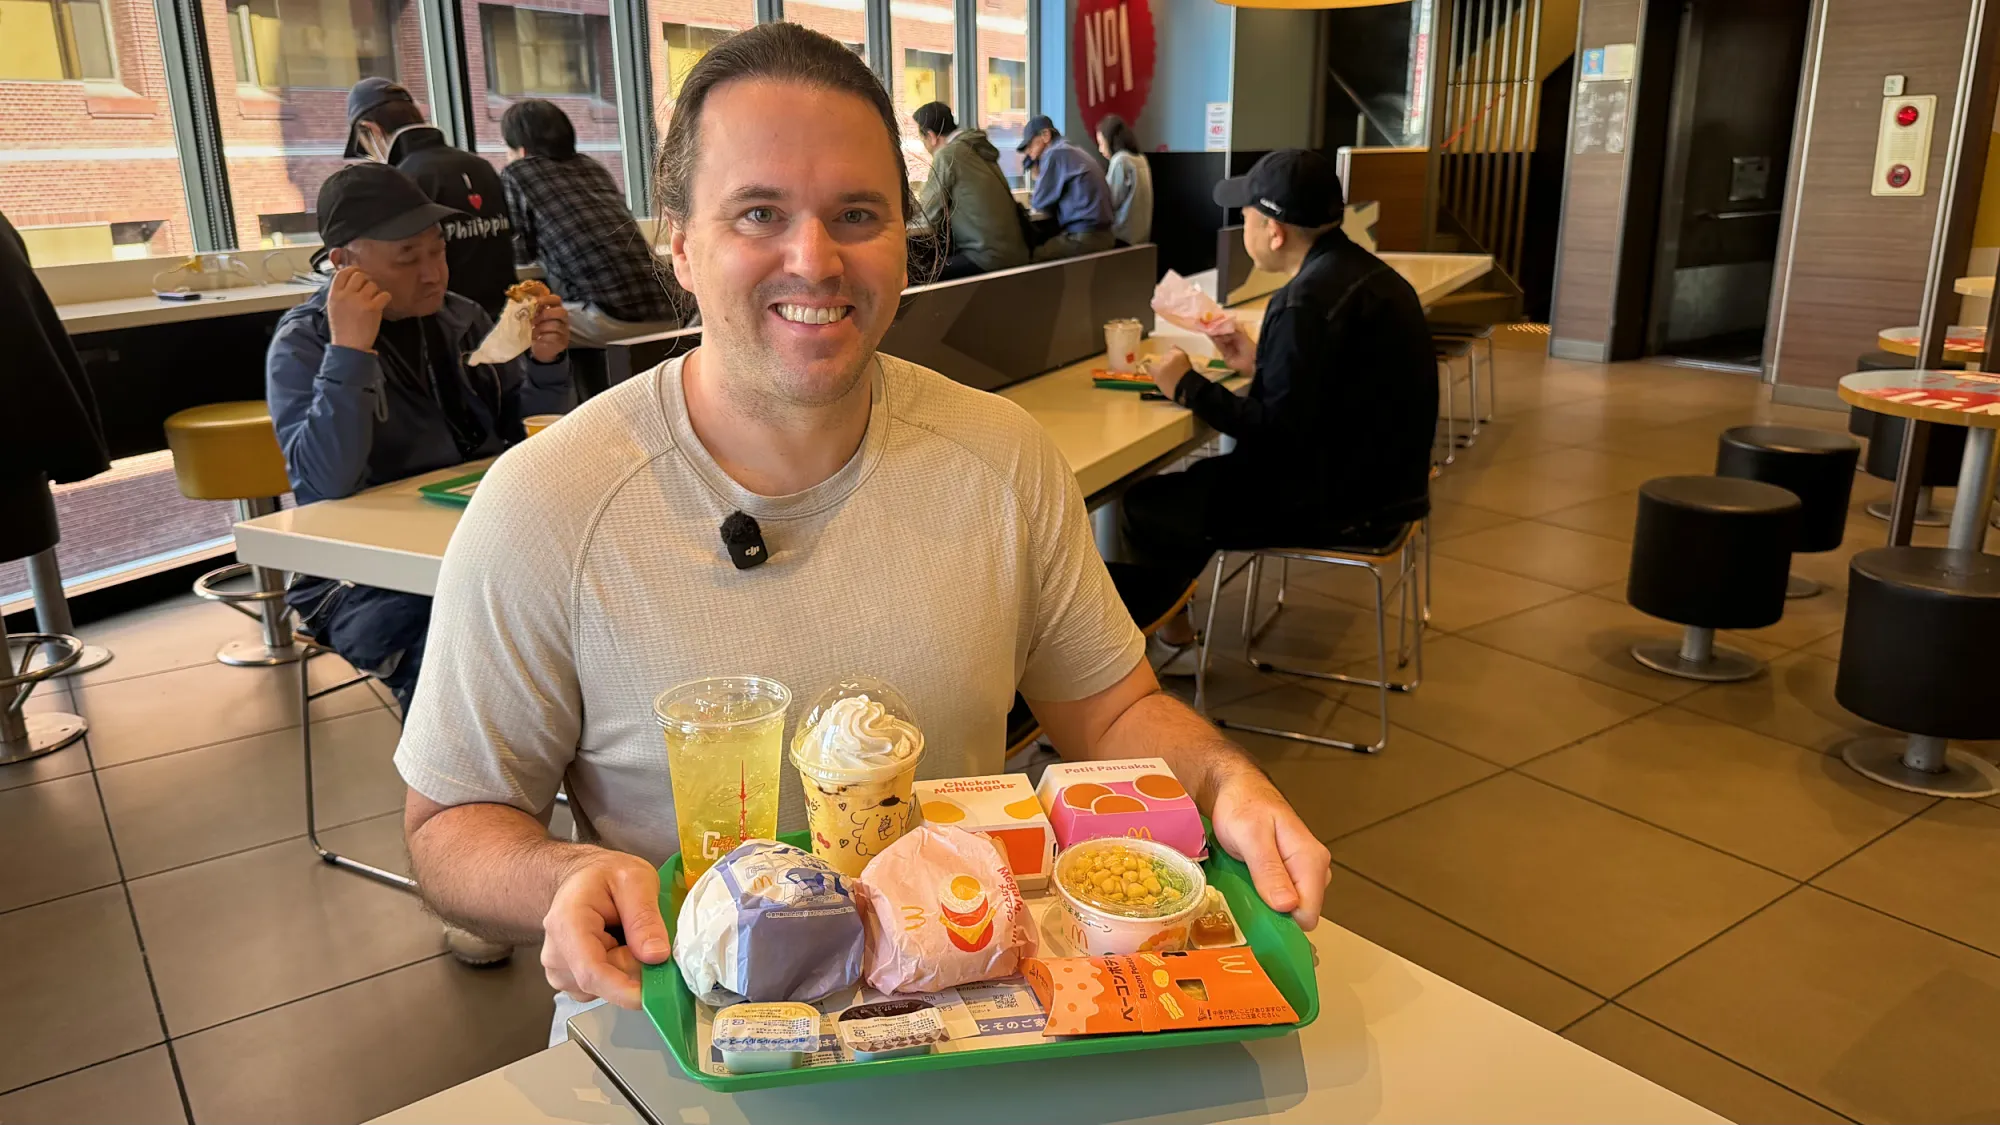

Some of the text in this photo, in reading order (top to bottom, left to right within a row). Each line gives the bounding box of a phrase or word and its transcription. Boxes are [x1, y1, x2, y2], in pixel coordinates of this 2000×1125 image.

[1065, 763, 1156, 774] Petit Pancakes
[944, 779, 1001, 788] Chicken
[997, 866, 1020, 897] Mega
[1135, 975, 1148, 999] Bacon
